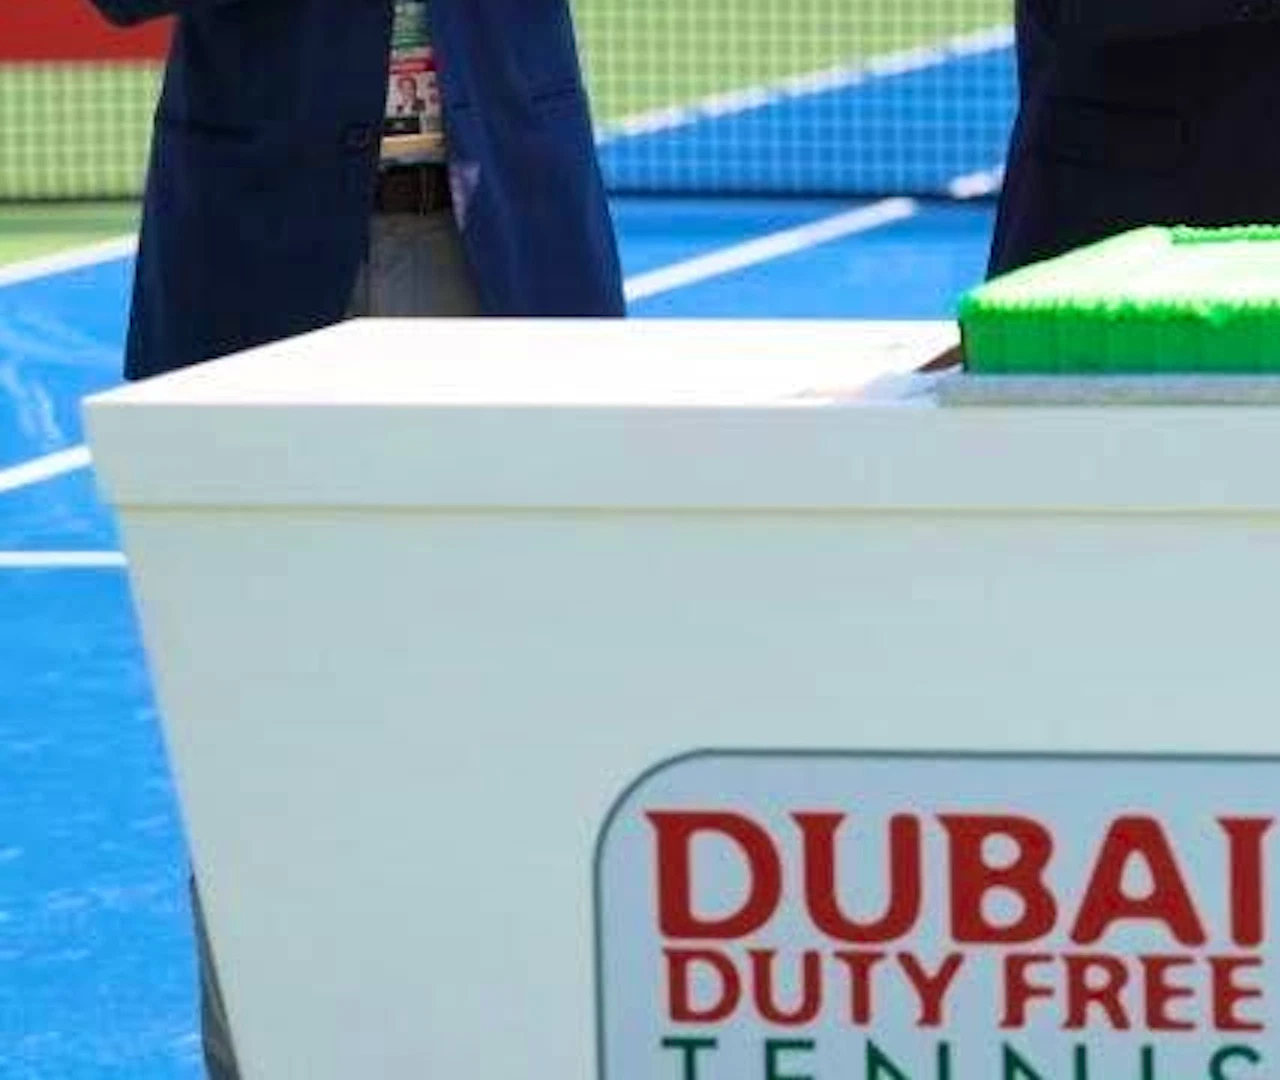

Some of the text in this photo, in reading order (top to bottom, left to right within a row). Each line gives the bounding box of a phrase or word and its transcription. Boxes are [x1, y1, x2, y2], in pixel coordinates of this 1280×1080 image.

[644, 810, 1276, 947] DUBAI
[663, 947, 1266, 1032] DUTY FREE
